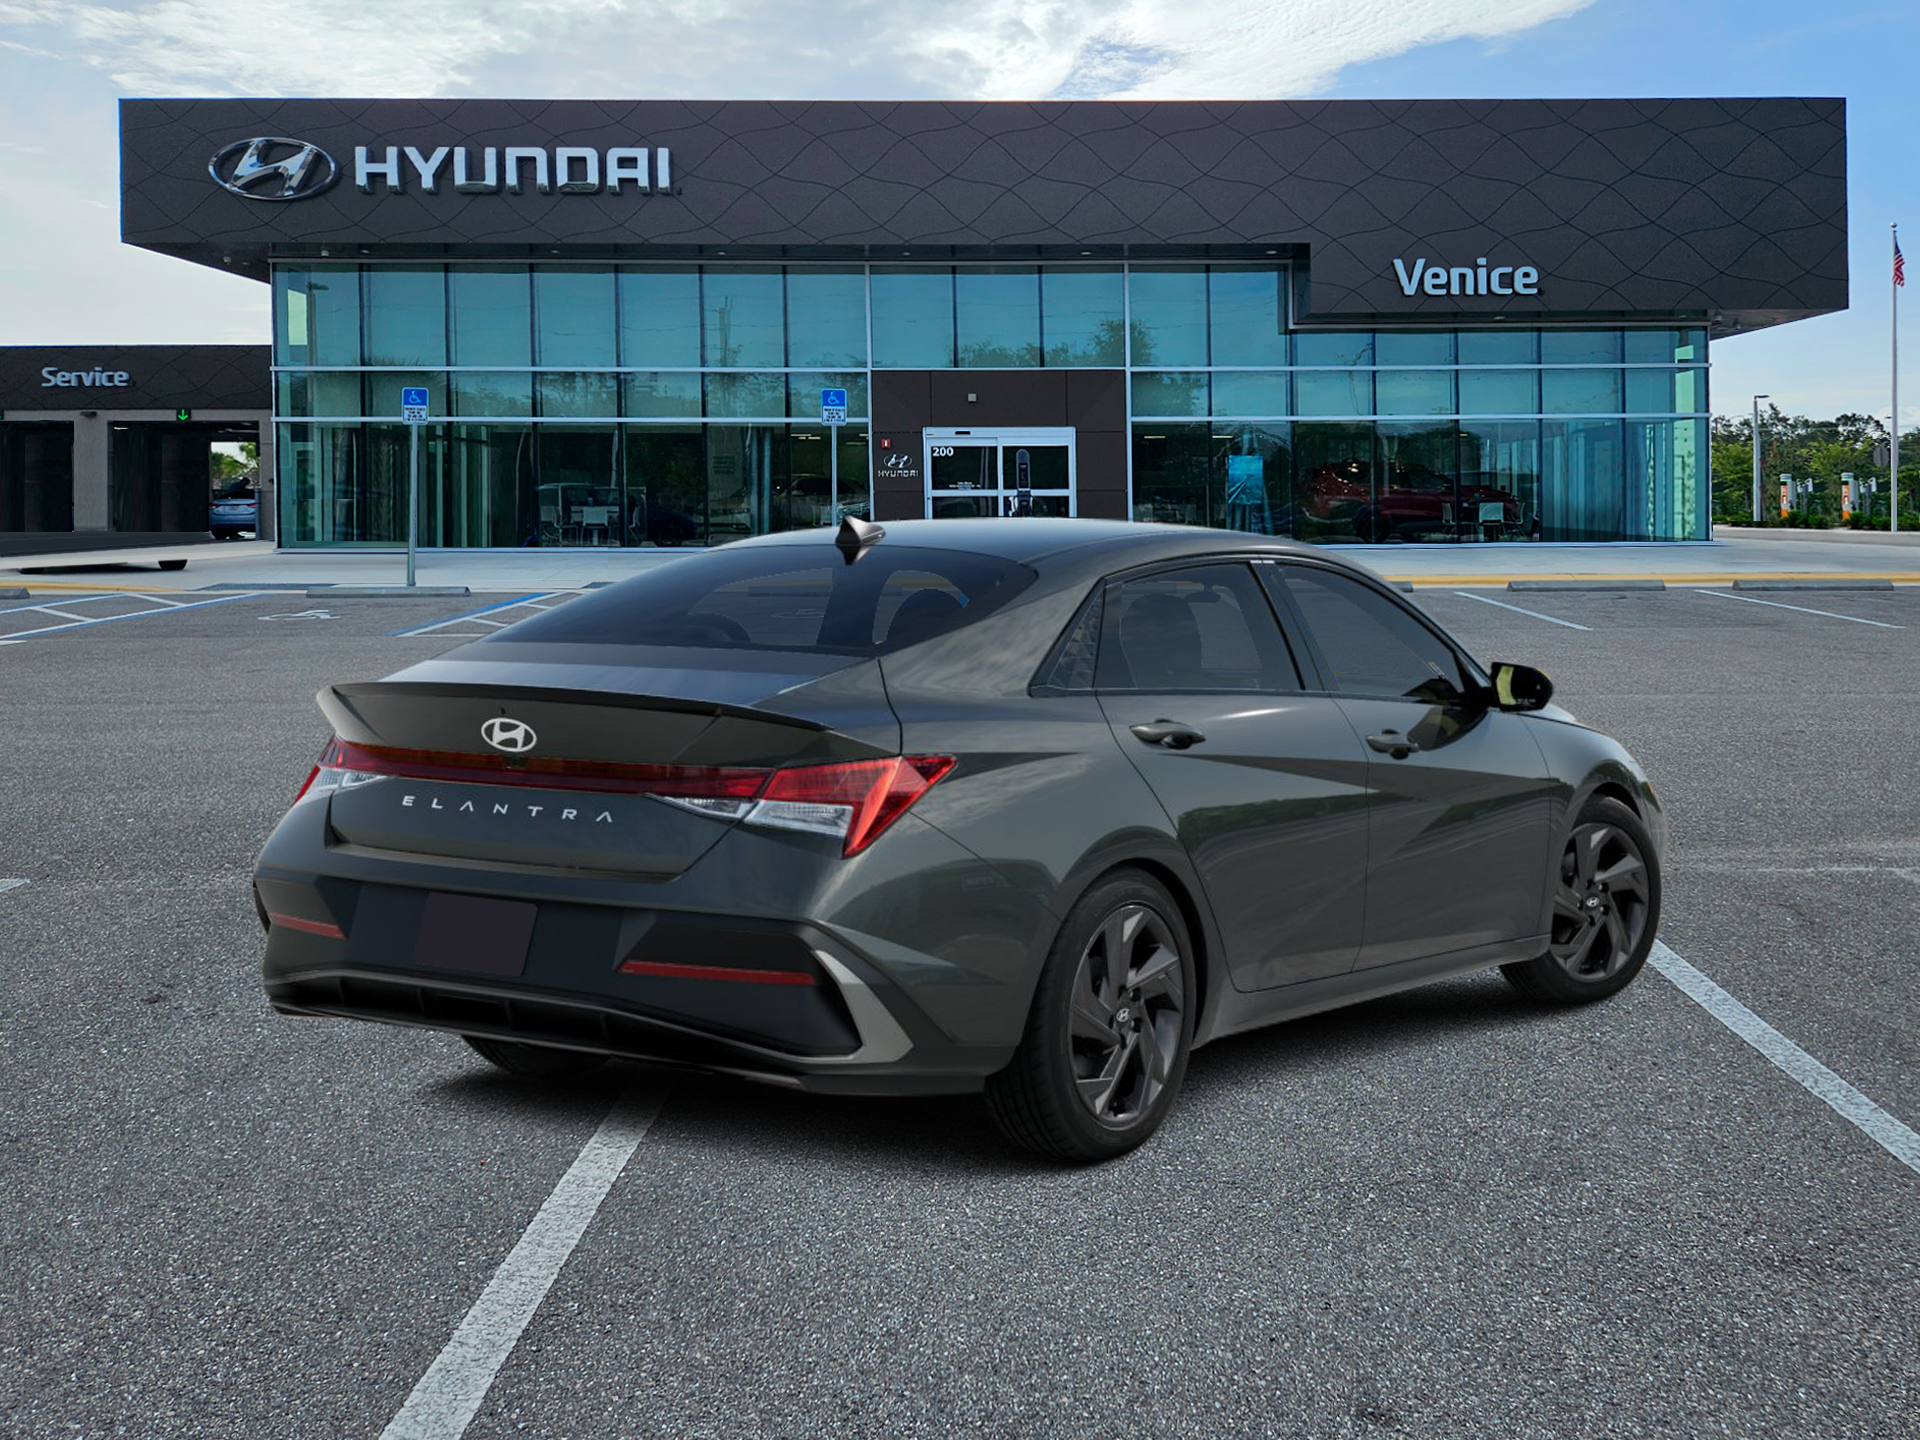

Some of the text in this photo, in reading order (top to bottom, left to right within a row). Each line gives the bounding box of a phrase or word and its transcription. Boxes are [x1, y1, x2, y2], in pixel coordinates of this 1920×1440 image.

[355, 146, 671, 193] HYUNDAI
[1392, 256, 1540, 296] Venice
[41, 366, 130, 388] Service
[932, 446, 954, 457] 200
[878, 469, 919, 478] HYUNDAI
[402, 795, 613, 823] ELANTRA
